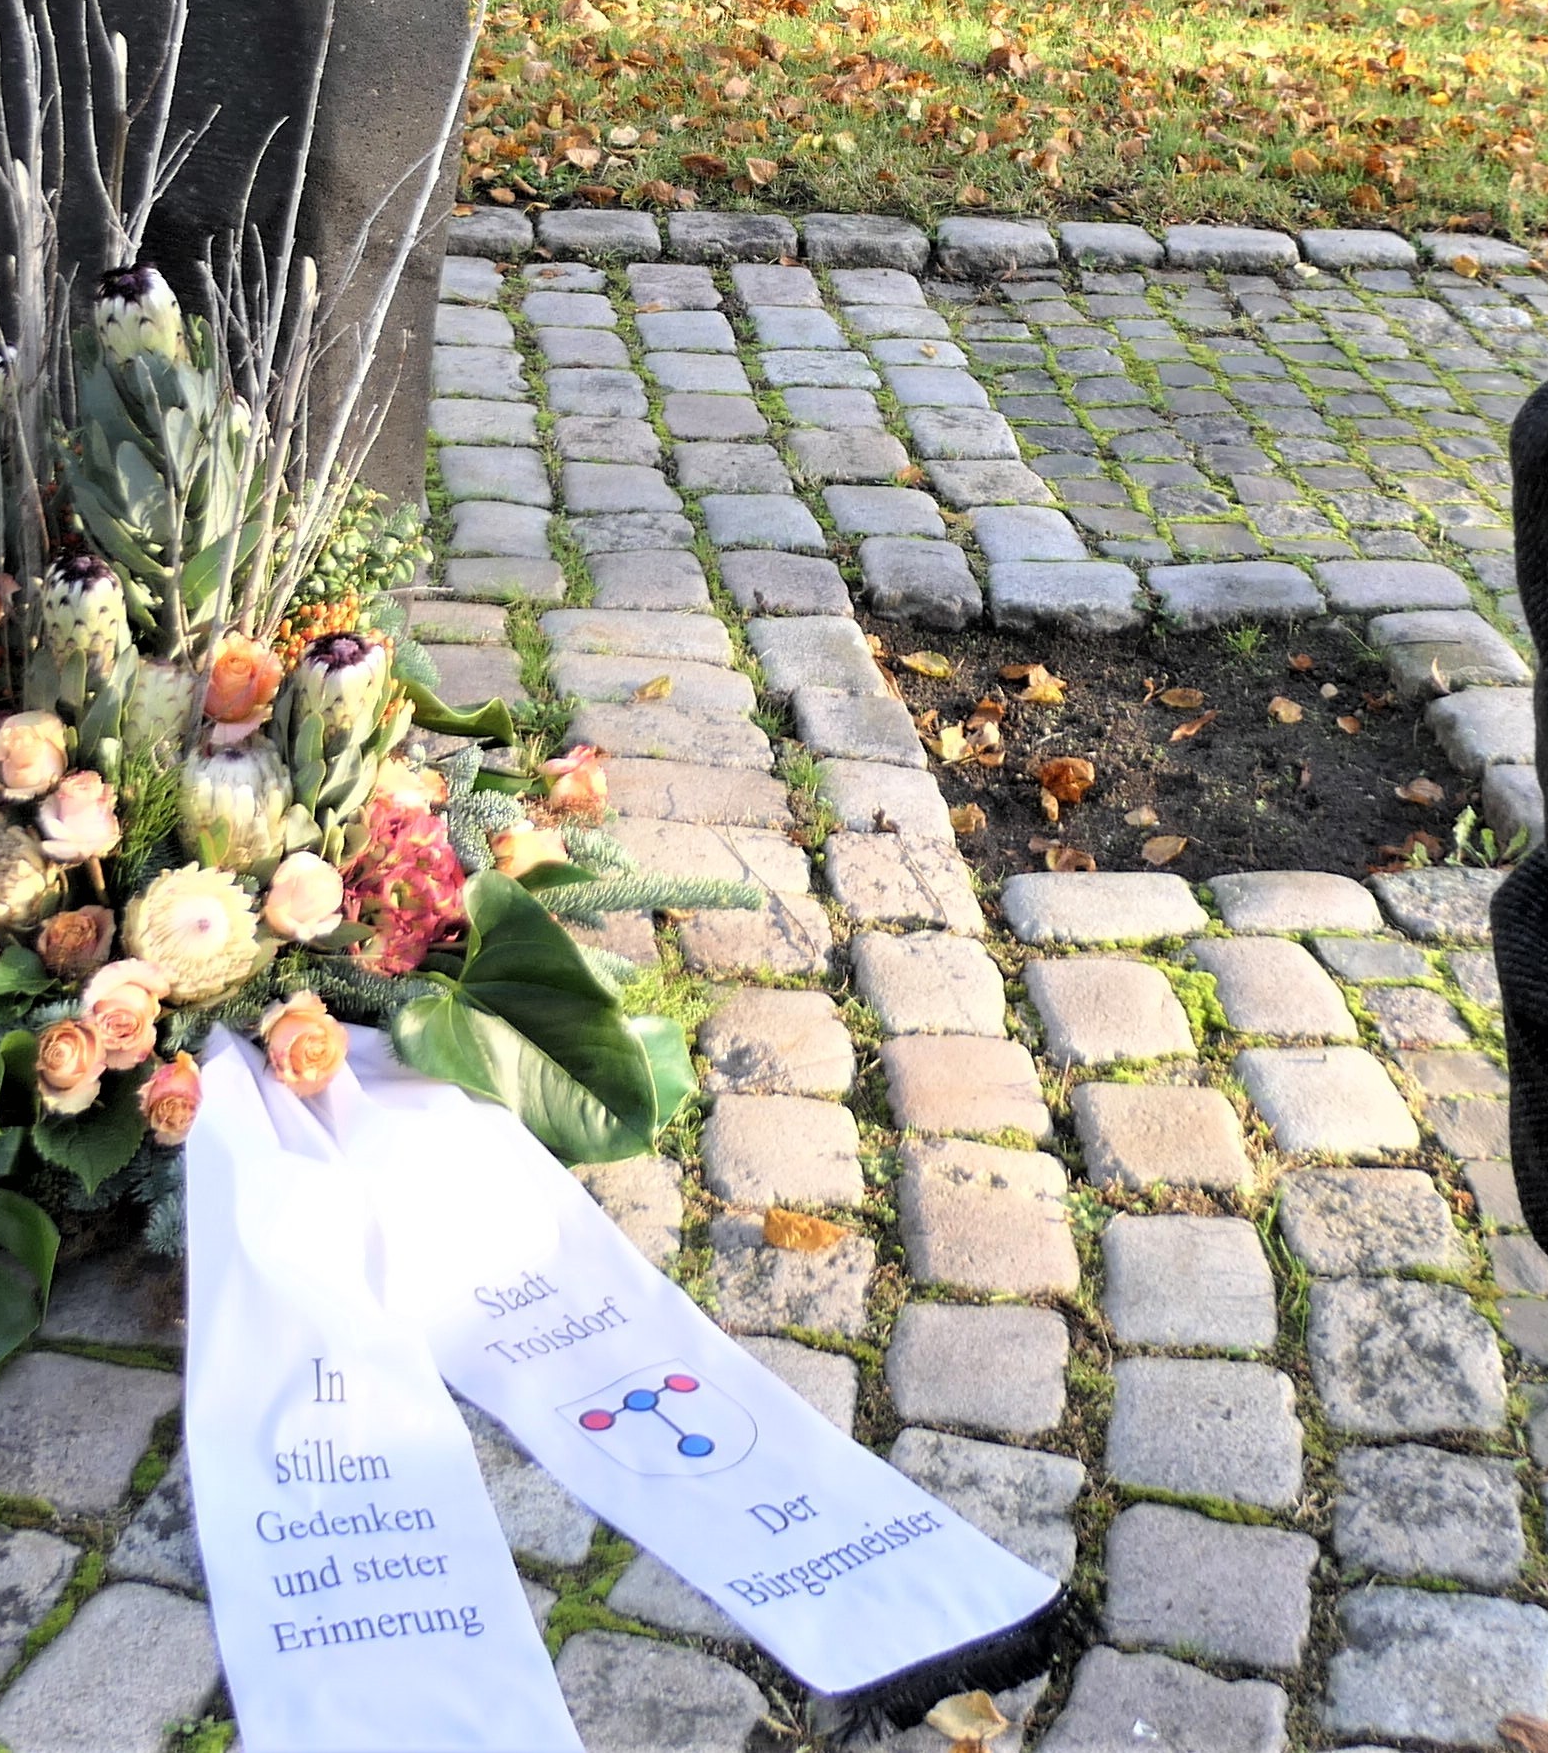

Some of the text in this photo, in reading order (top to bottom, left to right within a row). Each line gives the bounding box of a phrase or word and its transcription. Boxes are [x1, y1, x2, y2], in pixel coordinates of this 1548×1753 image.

[473, 1271, 558, 1319] Stadt
[485, 1295, 632, 1367] Troisdorf
[311, 1357, 348, 1403] In
[275, 1439, 391, 1485] stillem
[255, 1502, 437, 1543] Gedenken
[746, 1491, 821, 1535] Der
[272, 1553, 451, 1598] und steter
[724, 1505, 946, 1608] Bürgermeister
[270, 1602, 485, 1653] Erinnerung
